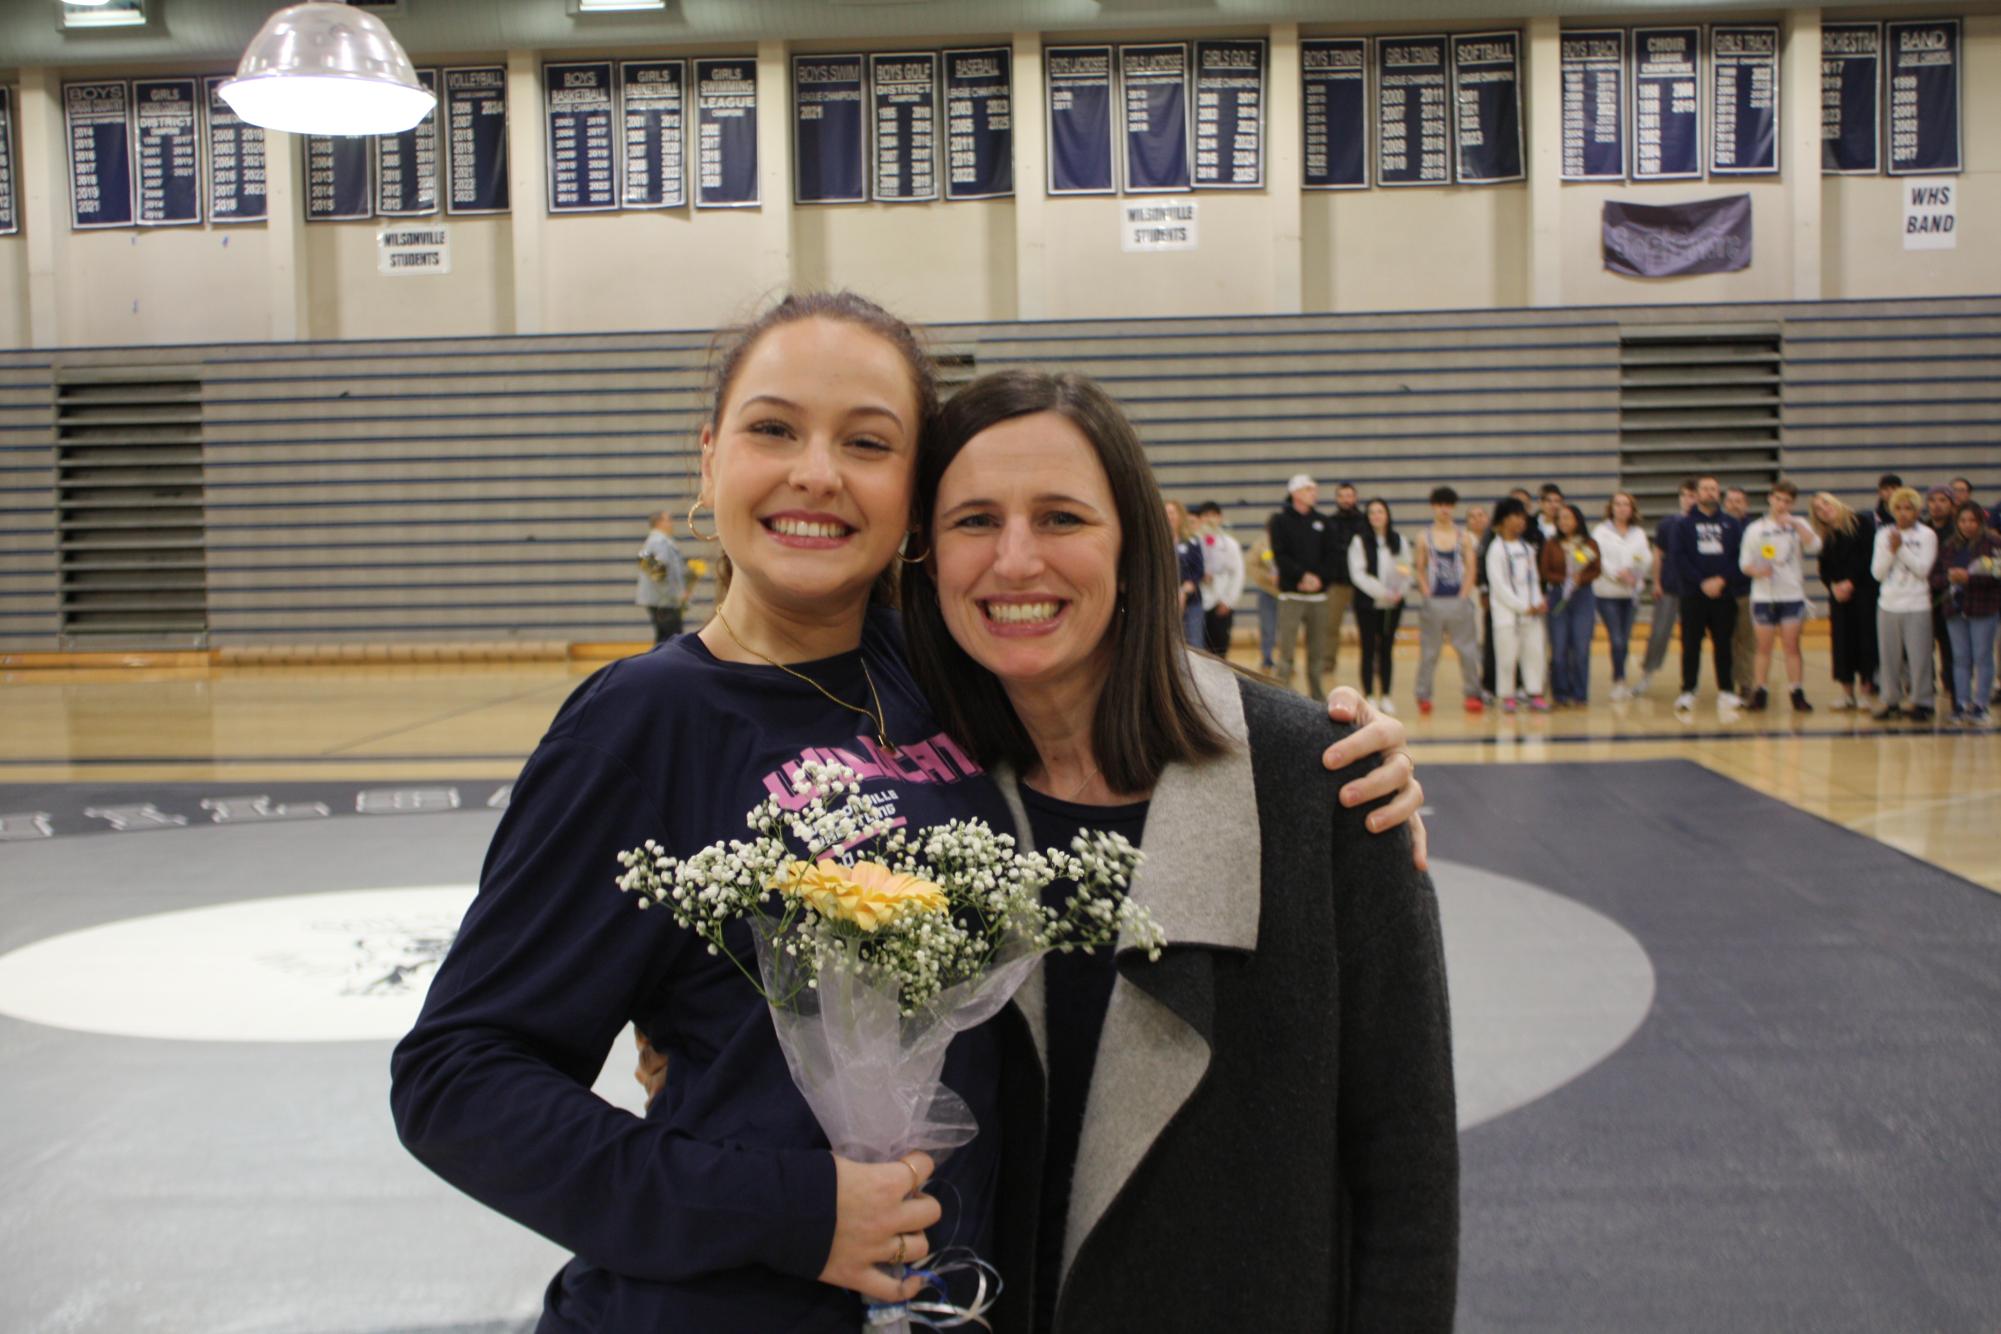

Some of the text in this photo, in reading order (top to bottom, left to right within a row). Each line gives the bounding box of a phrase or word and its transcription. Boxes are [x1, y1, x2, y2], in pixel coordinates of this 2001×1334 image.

[1647, 38, 1686, 52] CHOIR
[1716, 34, 1774, 51] GIRLS TRACK
[1822, 31, 1876, 52] RCHESTRA
[1901, 30, 1947, 49] BAND
[1202, 50, 1257, 66] GIRLS GOLF
[1303, 49, 1361, 66] BOYS TENNIS
[1385, 46, 1439, 64] GIRLS TENNIS
[1457, 44, 1513, 62] SOFTBALL
[798, 65, 860, 81] BOYS SWIM
[877, 63, 931, 80] BOYS GOLF
[955, 59, 998, 75] BASEBALL
[1641, 63, 1693, 74] CHAMPIONS
[448, 72, 504, 88] VOLLEYBALL
[564, 71, 597, 84] BOYS
[637, 70, 669, 82] GIRLS
[711, 68, 743, 81] GIRLS
[700, 81, 754, 93] SWIMMING
[1893, 75, 1918, 89] 1999
[69, 87, 123, 100] BOYS
[150, 88, 180, 102] GIRLS
[551, 88, 606, 101] BASKETBALL
[625, 83, 679, 96] BASKETBALL
[876, 84, 932, 95] DISTRICT
[1420, 88, 1444, 103] 2011
[700, 96, 755, 108] LEAGUE
[950, 101, 973, 116] 2003
[140, 116, 192, 128] DISTRICT
[452, 115, 473, 128] 2007
[74, 127, 95, 138] 2014
[75, 138, 96, 150] 2015
[453, 141, 474, 155] 2019
[951, 136, 975, 151] 2011
[951, 151, 976, 167] 2019
[1893, 147, 1918, 161] 2017
[76, 162, 98, 174] 2017
[77, 186, 100, 200] 2019
[215, 184, 238, 197] 2017
[312, 184, 335, 198] 2014
[1911, 187, 1950, 206] WHS
[78, 200, 101, 213] 2021
[1127, 207, 1192, 222] WILSONVILLE
[1906, 215, 1955, 234] BAND
[384, 231, 444, 247] WILSONVILLE
[1134, 227, 1186, 243] STUDENTS
[390, 252, 439, 267] STUDENTS
